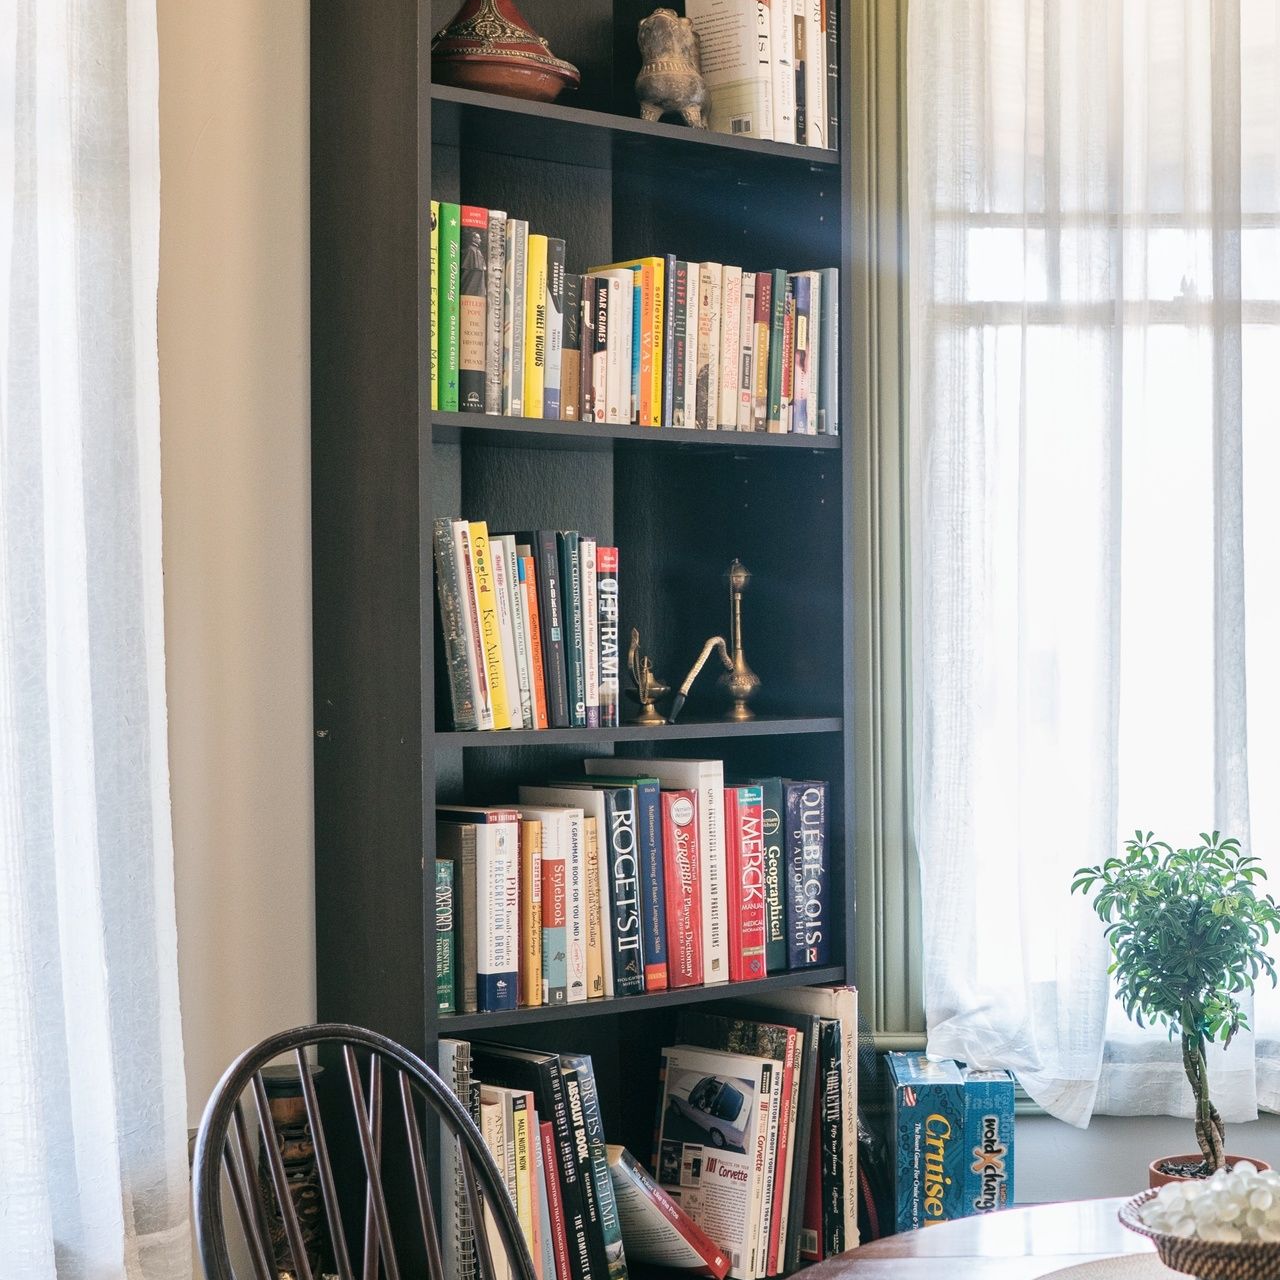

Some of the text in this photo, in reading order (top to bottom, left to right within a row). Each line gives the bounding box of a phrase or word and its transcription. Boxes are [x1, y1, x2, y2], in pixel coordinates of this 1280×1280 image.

[758, 34, 768, 52] Is
[447, 240, 458, 301] Tim Dorsey
[677, 270, 685, 305] STIFF
[598, 289, 607, 343] WAR CRIMES
[535, 304, 545, 367] SWEET VICIOUS
[642, 331, 651, 373] WAS
[474, 536, 489, 593] Googled
[483, 609, 494, 631] Ken
[601, 578, 618, 690] OFF RAMP
[488, 641, 500, 689] Auletta
[648, 805, 657, 847] Multisensory
[650, 848, 658, 878] Teaching
[741, 816, 762, 902] MERCK
[802, 787, 825, 945] QUÉBÉCOIS
[506, 876, 517, 907] PDR
[551, 864, 564, 926] Stylebook
[611, 810, 639, 952] ROGET'S II
[768, 845, 783, 942] Geographical
[793, 830, 803, 946] D'AUJOURD'HUI
[435, 886, 453, 931] OXFORD
[494, 860, 504, 967] PRESCRIPTION DRUGS
[587, 868, 597, 948] Powerful Vocabulary
[651, 905, 660, 936] Language
[674, 829, 694, 978] SCRABBLE Players Dictionary
[442, 938, 450, 976] ESSENTIAL
[505, 957, 511, 966] to
[549, 1065, 558, 1078] THE
[551, 1079, 560, 1091] ART
[773, 1071, 781, 1085] HOW
[553, 1092, 561, 1101] OF
[566, 1080, 584, 1128] ABSOLUT
[759, 1101, 769, 1112] 101
[773, 1086, 780, 1095] TO
[825, 1070, 840, 1122] CORVETTE
[554, 1101, 569, 1137] SCOTT
[771, 1097, 779, 1123] RESTORE
[517, 1118, 527, 1171] MALE NUDE NOW
[575, 1129, 589, 1163] BOOK.
[754, 1134, 766, 1172] Corvette
[769, 1131, 777, 1155] MODIFY
[830, 1140, 838, 1153] Year
[560, 1141, 576, 1184] JACOBS
[704, 1156, 718, 1173] 101
[718, 1163, 749, 1183] Corvette
[830, 1154, 838, 1176] History
[924, 1113, 951, 1217] Cruise
[584, 1172, 593, 1197] RICHARD
[765, 1173, 774, 1204] CORVETTE
[574, 1214, 583, 1230] THE
[587, 1204, 596, 1222] LEWIS
[762, 1207, 770, 1234] 1968-82
[576, 1232, 590, 1272] COMPLETE
